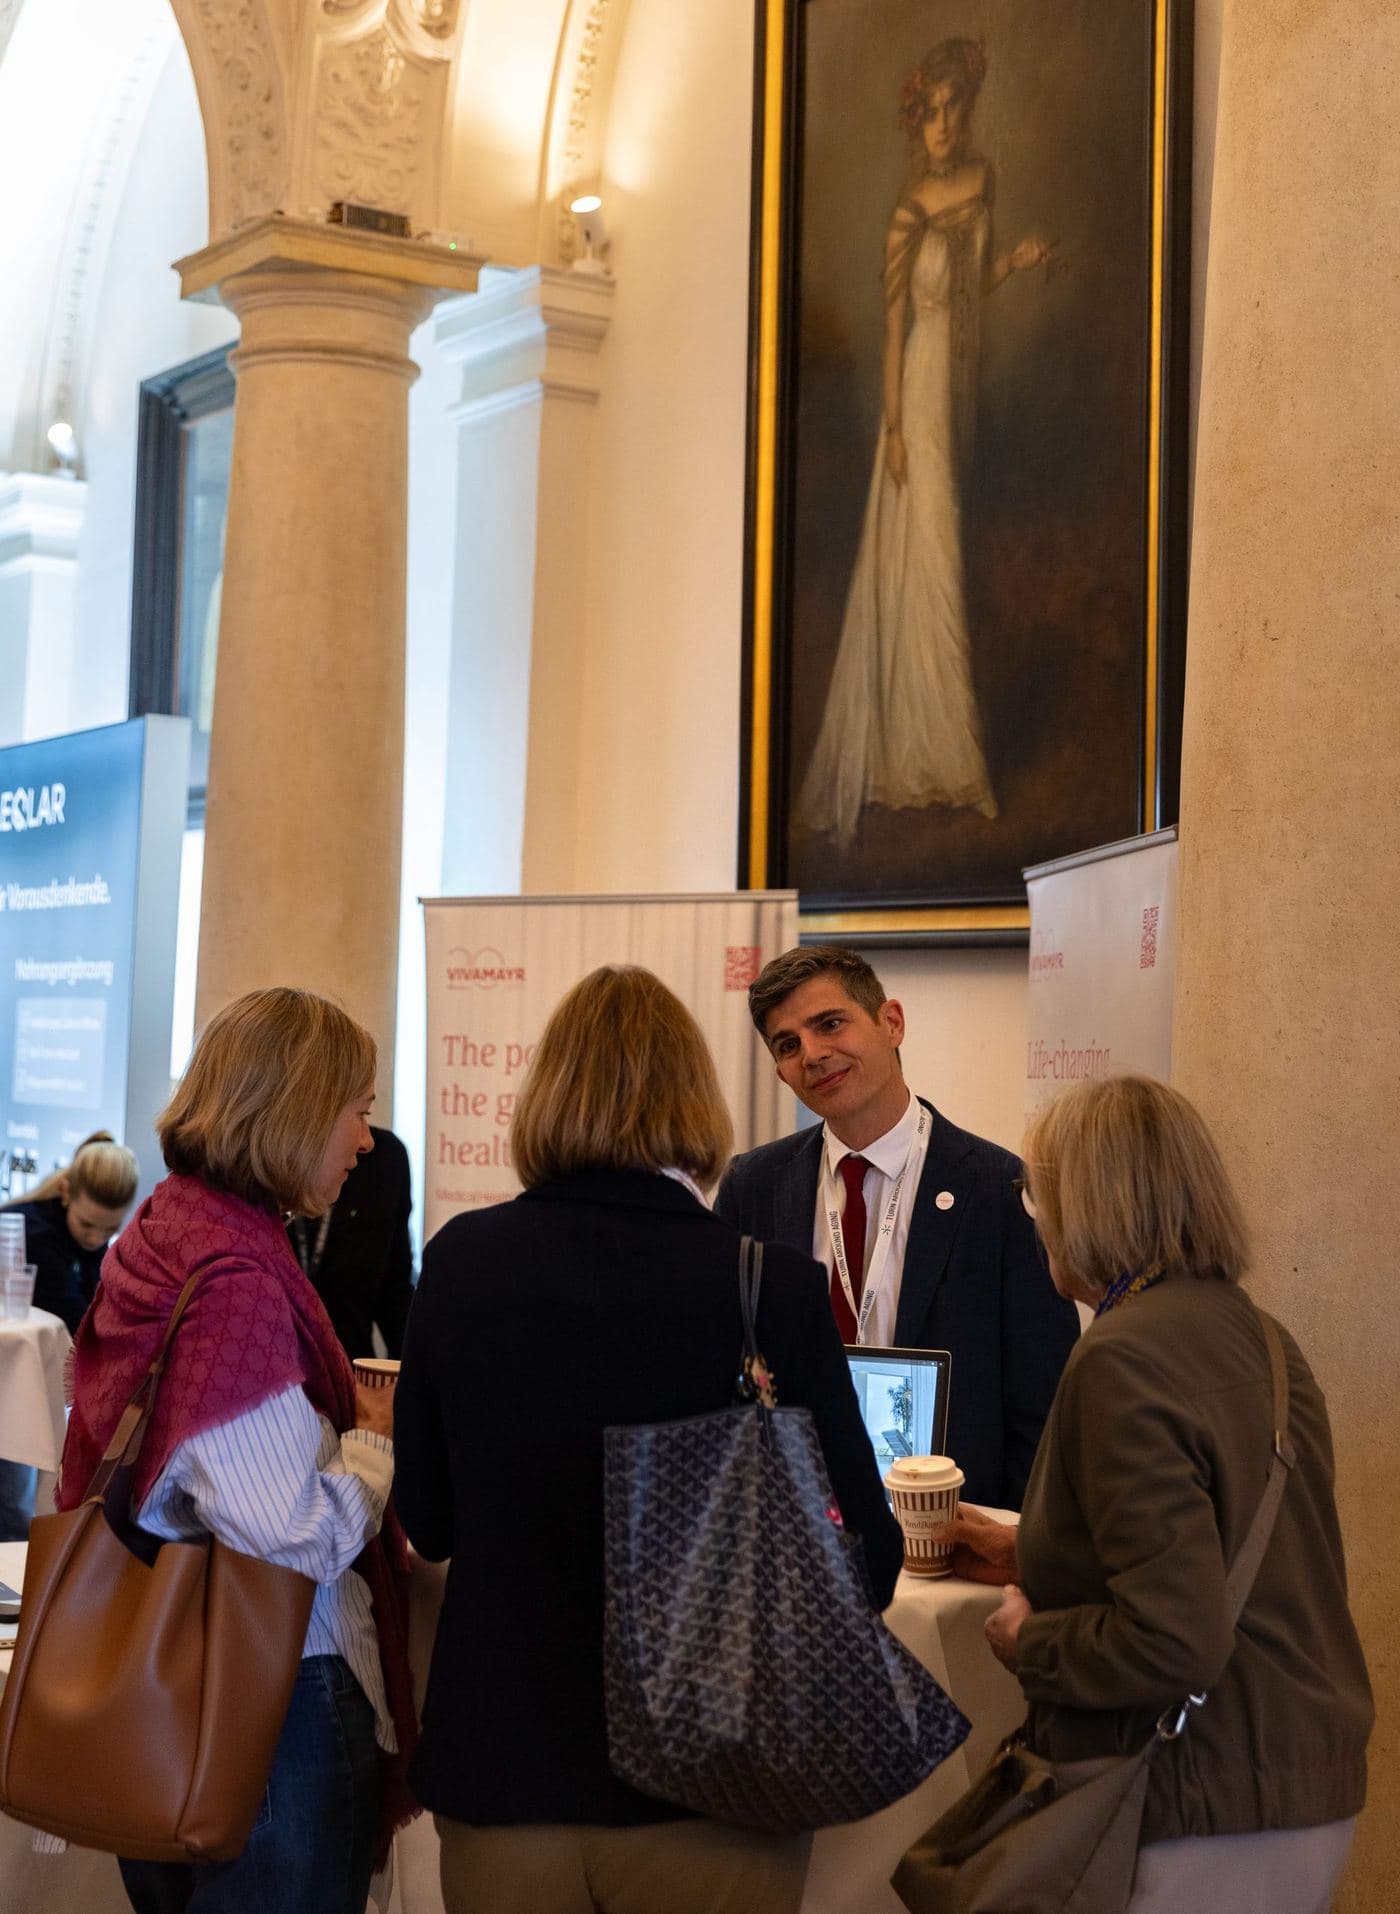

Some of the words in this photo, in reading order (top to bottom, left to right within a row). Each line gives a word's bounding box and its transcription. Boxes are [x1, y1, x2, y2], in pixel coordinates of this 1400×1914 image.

[447, 967, 526, 981] VIVAMAYR
[441, 1034, 497, 1067] The
[1027, 1039, 1110, 1079] Life-changing
[441, 1083, 488, 1116] the
[829, 1210, 839, 1230] AGING
[886, 1203, 896, 1220] TURN
[832, 1231, 843, 1257] AROUND
[863, 1290, 875, 1310] AGING
